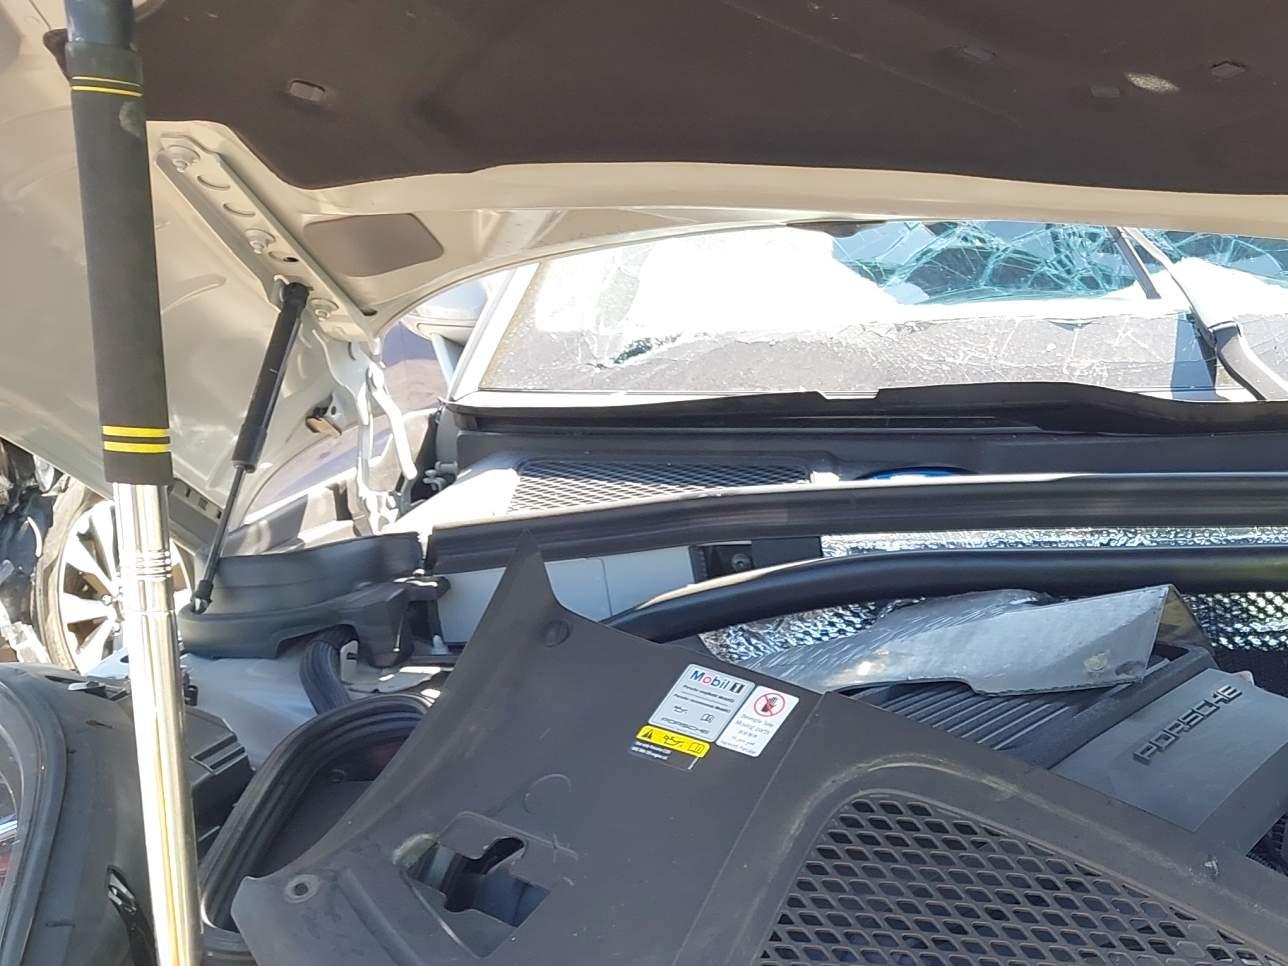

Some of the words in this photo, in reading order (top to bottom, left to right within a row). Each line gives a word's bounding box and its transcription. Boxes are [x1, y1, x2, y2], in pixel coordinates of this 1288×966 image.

[690, 670, 730, 689] Mobil
[730, 682, 746, 694] 1
[1133, 685, 1242, 765] PORSCHE
